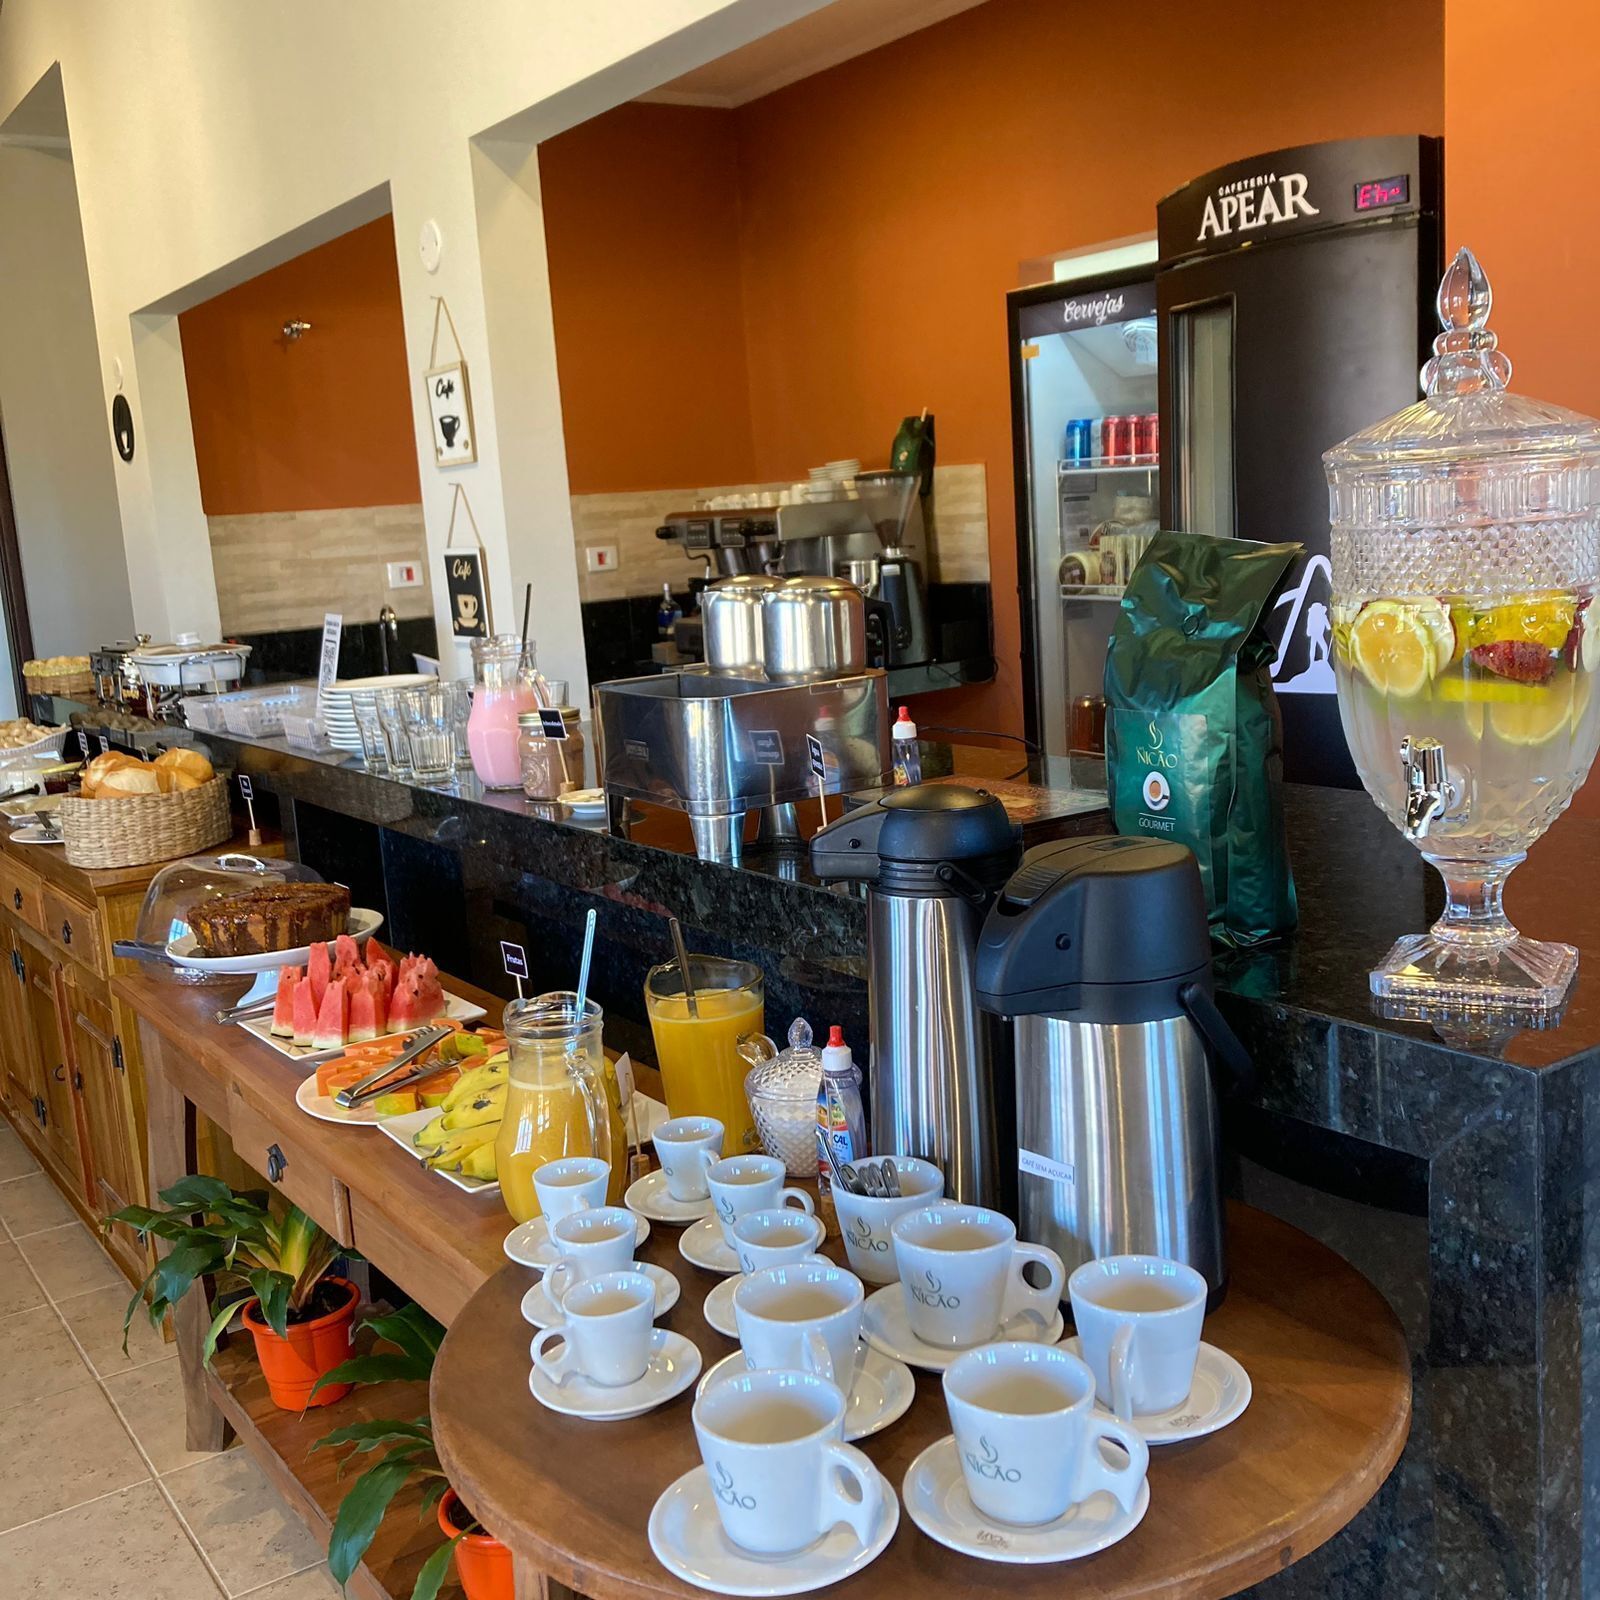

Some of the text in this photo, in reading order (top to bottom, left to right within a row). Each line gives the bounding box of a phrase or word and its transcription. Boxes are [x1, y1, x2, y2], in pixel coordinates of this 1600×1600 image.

[1218, 172, 1276, 196] CAFETERIA
[1197, 173, 1320, 241] APEAR
[1063, 293, 1125, 326] Cervejas
[1138, 817, 1176, 832] GOURMET
